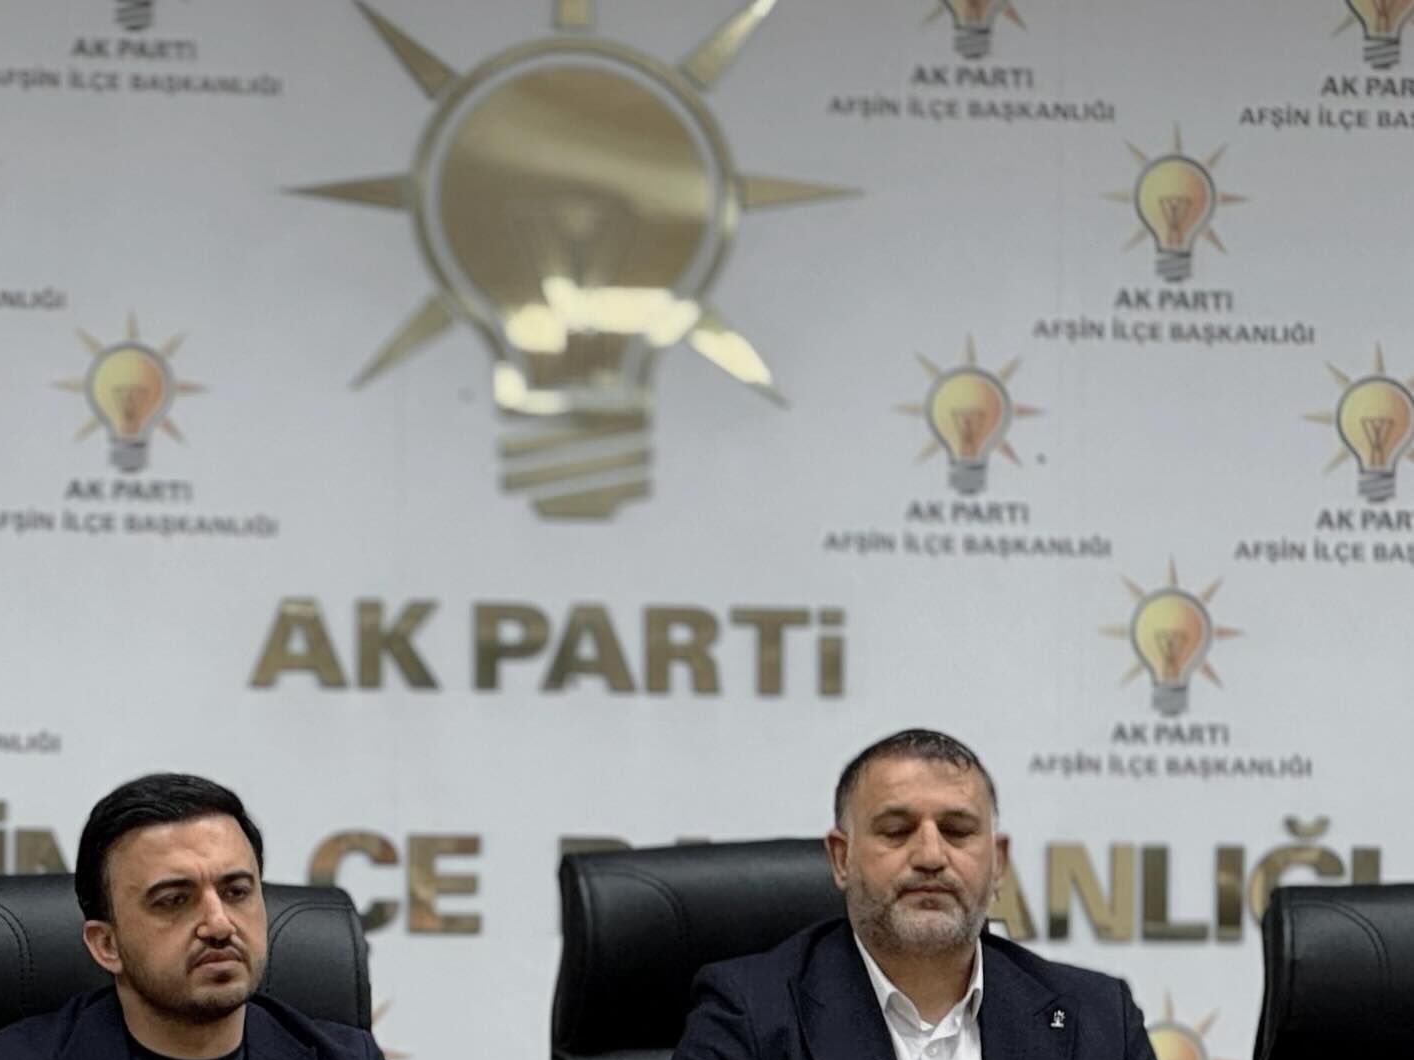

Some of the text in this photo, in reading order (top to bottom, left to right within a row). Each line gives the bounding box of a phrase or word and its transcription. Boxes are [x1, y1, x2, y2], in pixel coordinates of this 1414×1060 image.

[71, 39, 109, 57] AK
[911, 66, 948, 86] AK
[1321, 76, 1358, 96] AK
[828, 97, 900, 118] AFŞİN
[908, 97, 958, 121] İLÇE
[1240, 104, 1310, 129] AFŞİN
[1319, 99, 1368, 131] İLÇE
[1115, 289, 1151, 310] AK
[1033, 316, 1105, 343] AFŞİN
[1112, 317, 1161, 344] İLÇE
[65, 480, 105, 500] AK
[906, 502, 944, 522] AK
[1316, 509, 1354, 531] AK
[823, 532, 896, 555] AFŞİN
[903, 532, 954, 556] İLÇE
[1235, 537, 1306, 564] AFŞİN
[1314, 537, 1364, 565] İLÇE
[247, 599, 439, 690] AK
[1112, 724, 1147, 744] AK
[1029, 751, 1102, 778] AFŞİN
[1108, 753, 1158, 779] İLÇE
